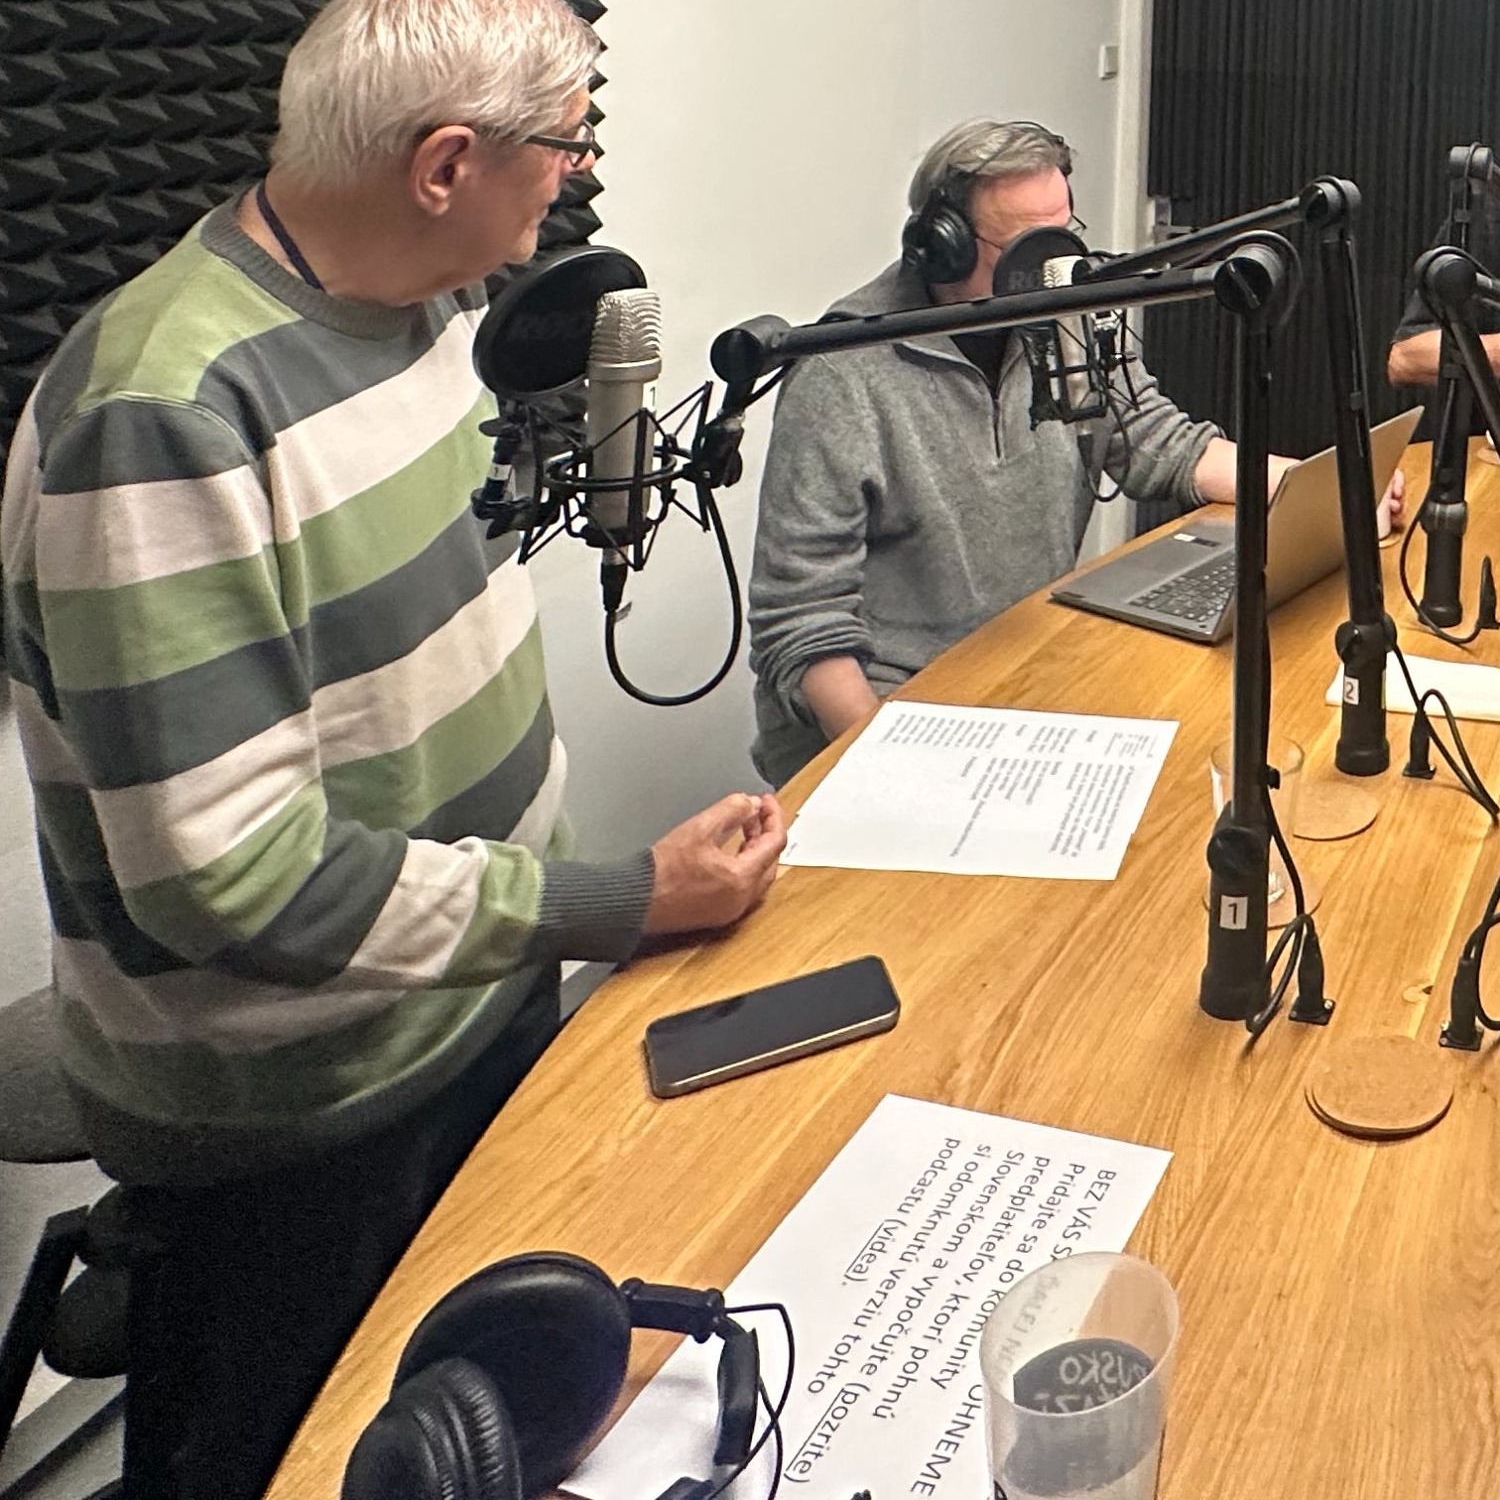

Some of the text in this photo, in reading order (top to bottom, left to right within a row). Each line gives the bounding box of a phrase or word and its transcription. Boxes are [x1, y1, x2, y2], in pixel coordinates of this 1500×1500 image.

[1345, 681, 1355, 700] 2
[1228, 902, 1239, 925] 1
[1084, 1169, 1117, 1202] BEZ
[841, 1137, 961, 1286] podcastu (videa).
[1062, 1206, 1097, 1241] VÁS
[808, 1143, 991, 1395] si odomknutú verziu tohto
[930, 1162, 1086, 1390] Pridajte sa do komunity
[1050, 1244, 1073, 1261] S
[783, 1150, 1025, 1483] Slovenskom a vypočujte (pozrite)
[923, 1293, 970, 1344] ktorí
[872, 1345, 929, 1419] pohnú
